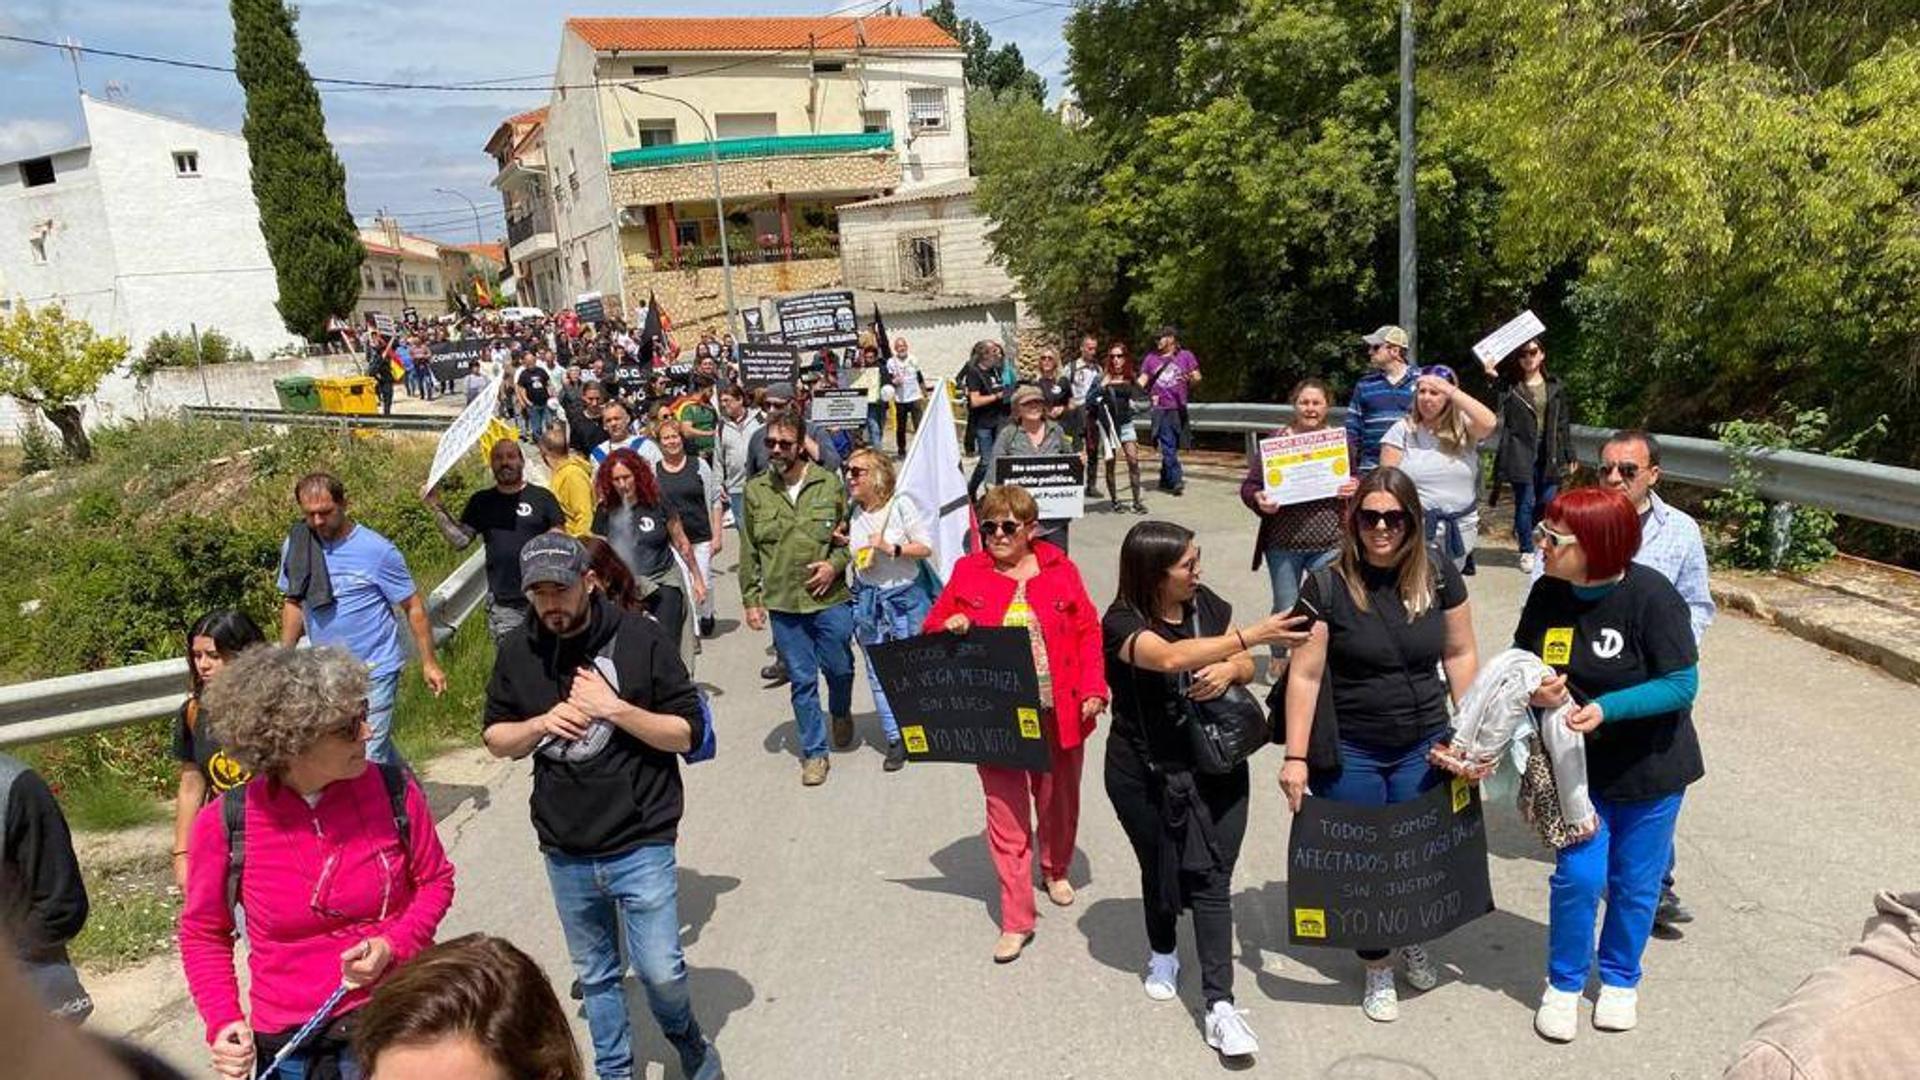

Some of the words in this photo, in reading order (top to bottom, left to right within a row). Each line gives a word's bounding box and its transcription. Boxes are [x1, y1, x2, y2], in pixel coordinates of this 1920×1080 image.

[1004, 475, 1038, 487] partido
[1012, 464, 1024, 472] No
[1026, 464, 1056, 472] somos
[1057, 463, 1069, 471] un
[928, 728, 951, 753] YO
[954, 728, 977, 753] NO
[980, 727, 1017, 755] VOTO
[1320, 818, 1378, 842] TODOS
[1389, 808, 1438, 838] SOMOS
[1295, 847, 1389, 873] AFECTADOS
[1395, 846, 1416, 870] DEL
[1343, 882, 1371, 898] SIN
[1333, 908, 1368, 934] YO
[1378, 907, 1409, 934] NO
[1419, 890, 1461, 929] VOTO
